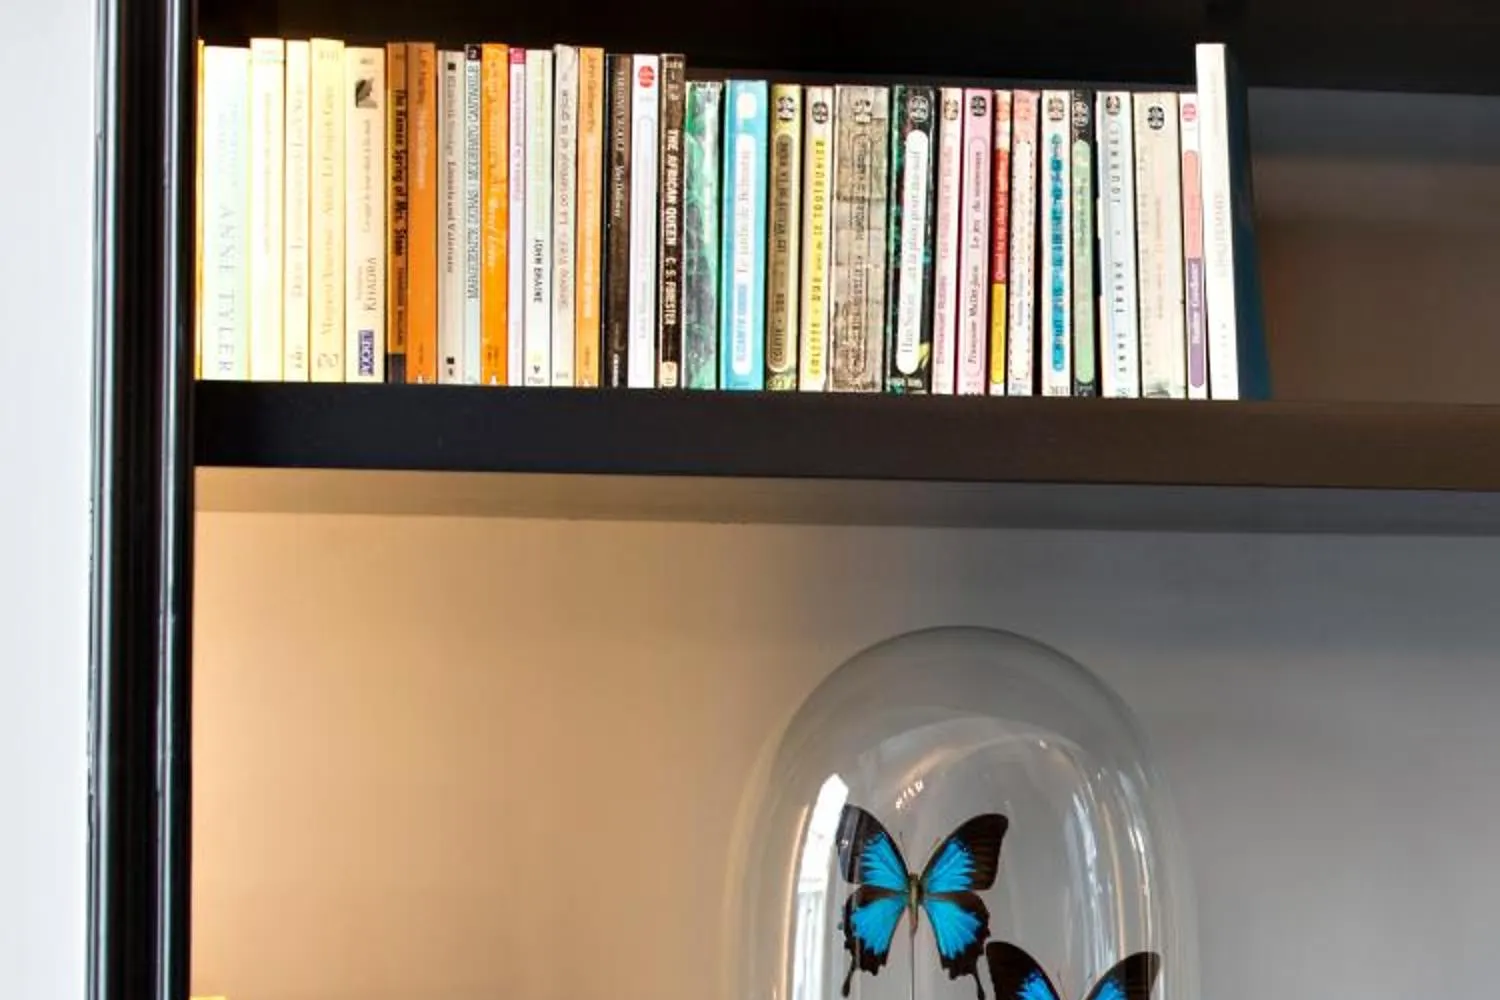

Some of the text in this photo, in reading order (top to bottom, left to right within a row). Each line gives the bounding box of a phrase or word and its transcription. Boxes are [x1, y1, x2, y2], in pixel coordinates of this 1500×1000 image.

[391, 150, 406, 184] Spring
[665, 129, 679, 246] THE AFRICAN QUEEN
[1108, 128, 1121, 203] JOURNAL
[394, 185, 405, 198] of
[218, 203, 236, 273] ANNE
[534, 240, 546, 264] JOHN
[363, 256, 378, 312] KHADRA
[533, 268, 545, 305] BRAINE
[665, 281, 678, 326] FORESTER
[218, 289, 236, 374] TYLER
